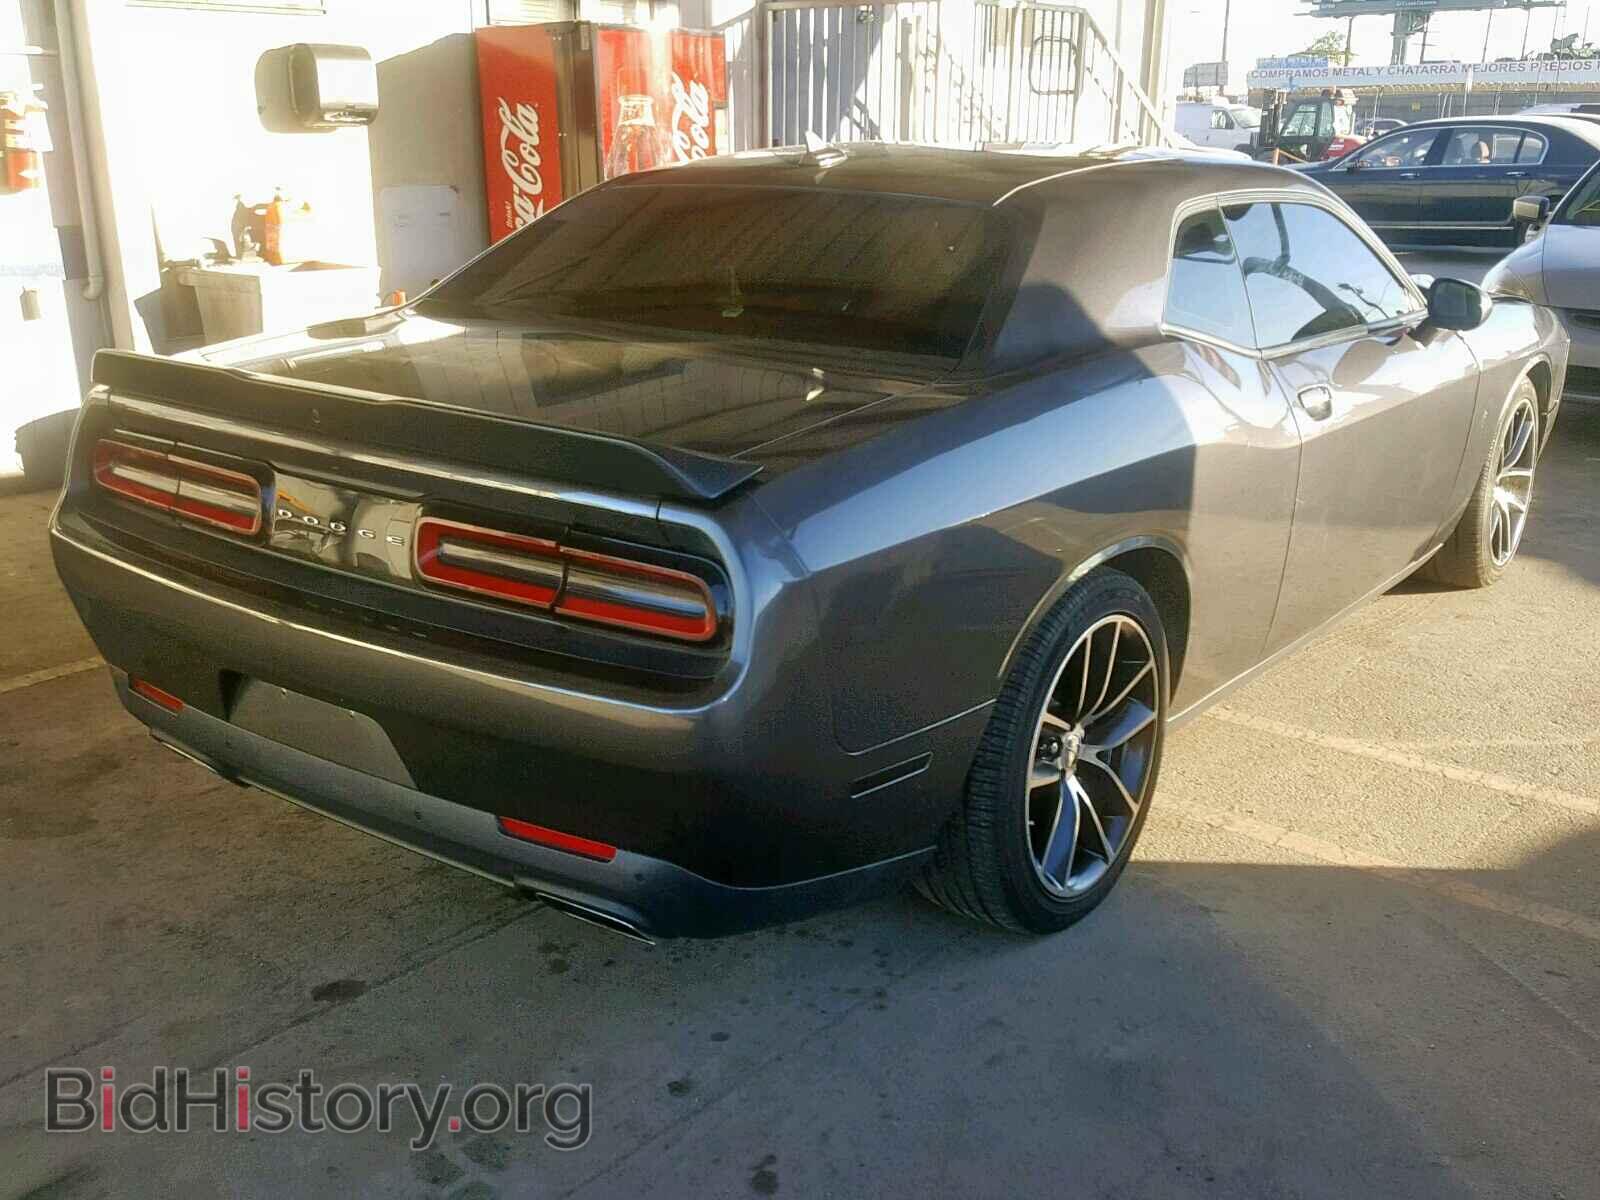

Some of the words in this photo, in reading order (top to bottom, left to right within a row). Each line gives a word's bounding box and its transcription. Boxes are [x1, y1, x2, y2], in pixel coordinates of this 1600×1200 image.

[1251, 68, 1329, 79] COMPRAMOS
[1332, 66, 1374, 77] METAL
[1376, 66, 1385, 75] Y
[1387, 65, 1457, 76] CHATARRA
[1461, 62, 1526, 73] MEJORES
[1530, 60, 1592, 72] PRECIOS
[278, 508, 405, 546] DODGE
